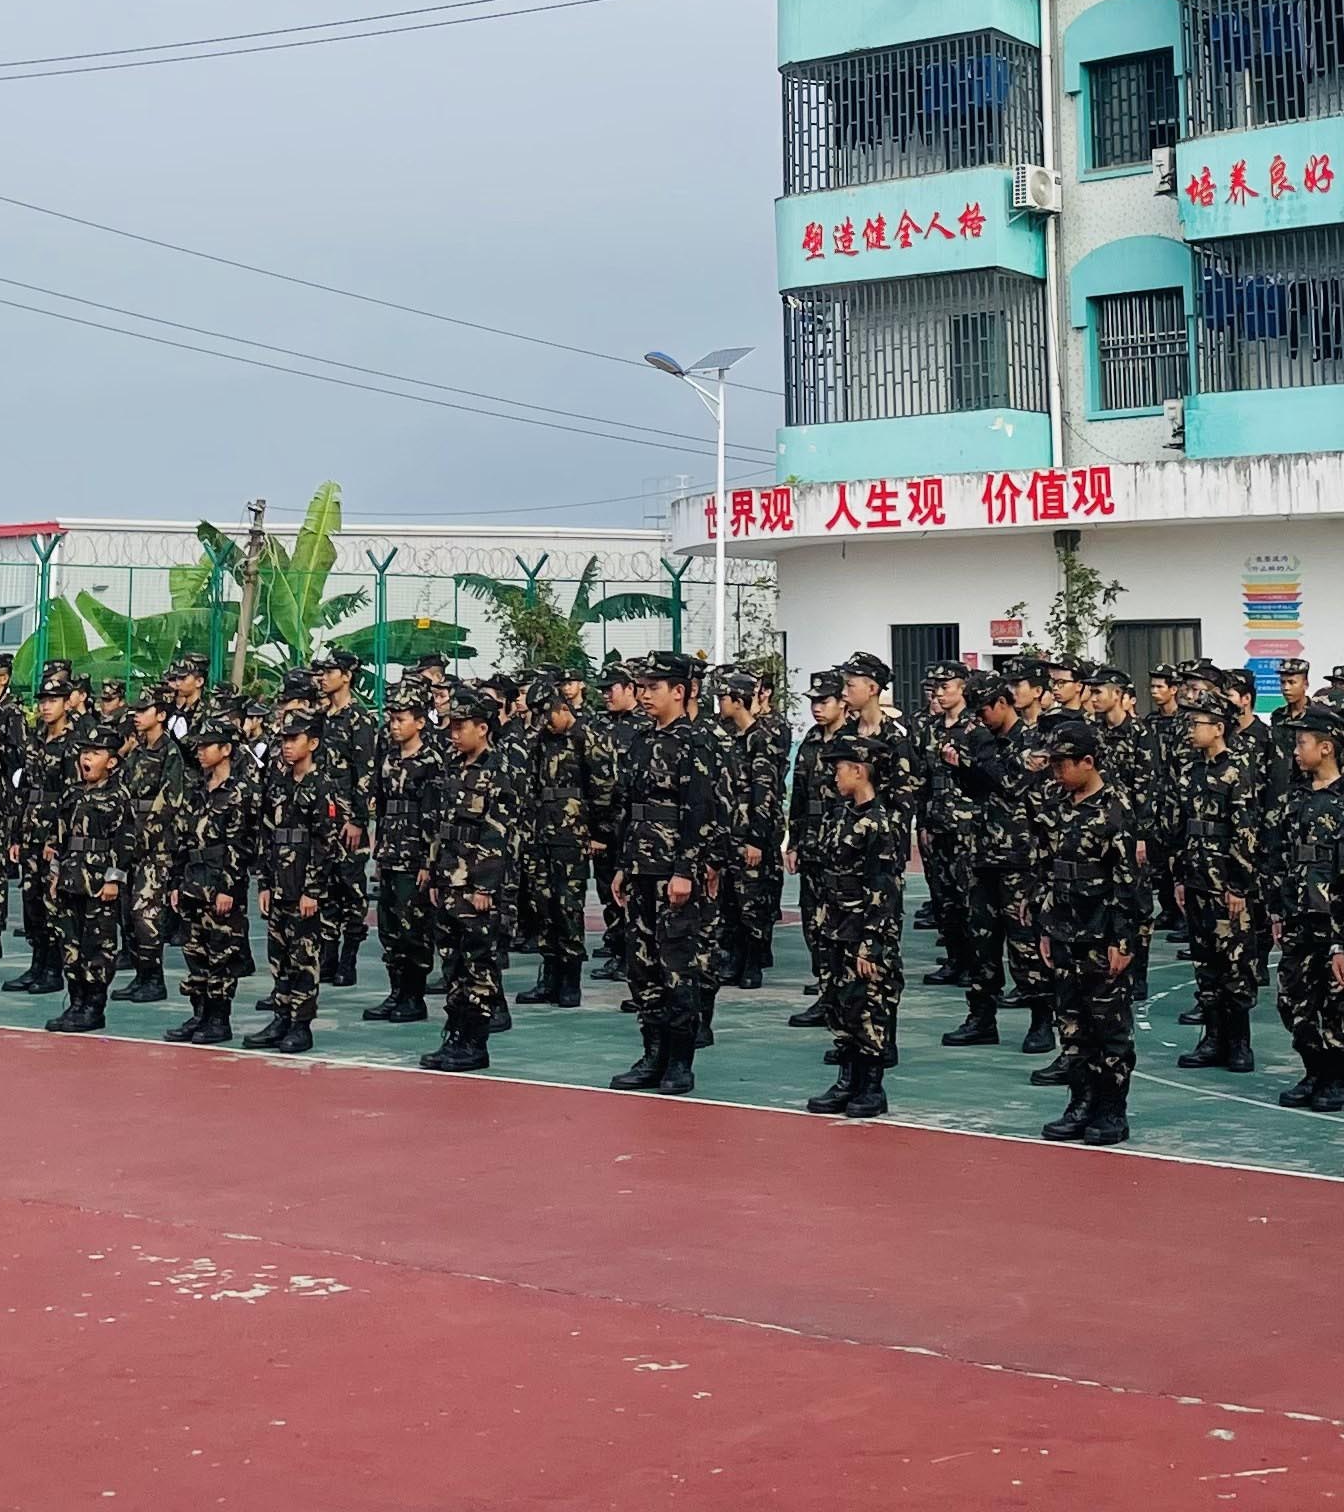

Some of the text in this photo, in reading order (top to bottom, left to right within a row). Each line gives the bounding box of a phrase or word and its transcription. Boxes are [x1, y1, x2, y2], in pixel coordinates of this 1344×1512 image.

[801, 201, 987, 261] 塑造健全人格
[825, 478, 946, 530] 人生观
[981, 466, 1116, 524] 价值观
